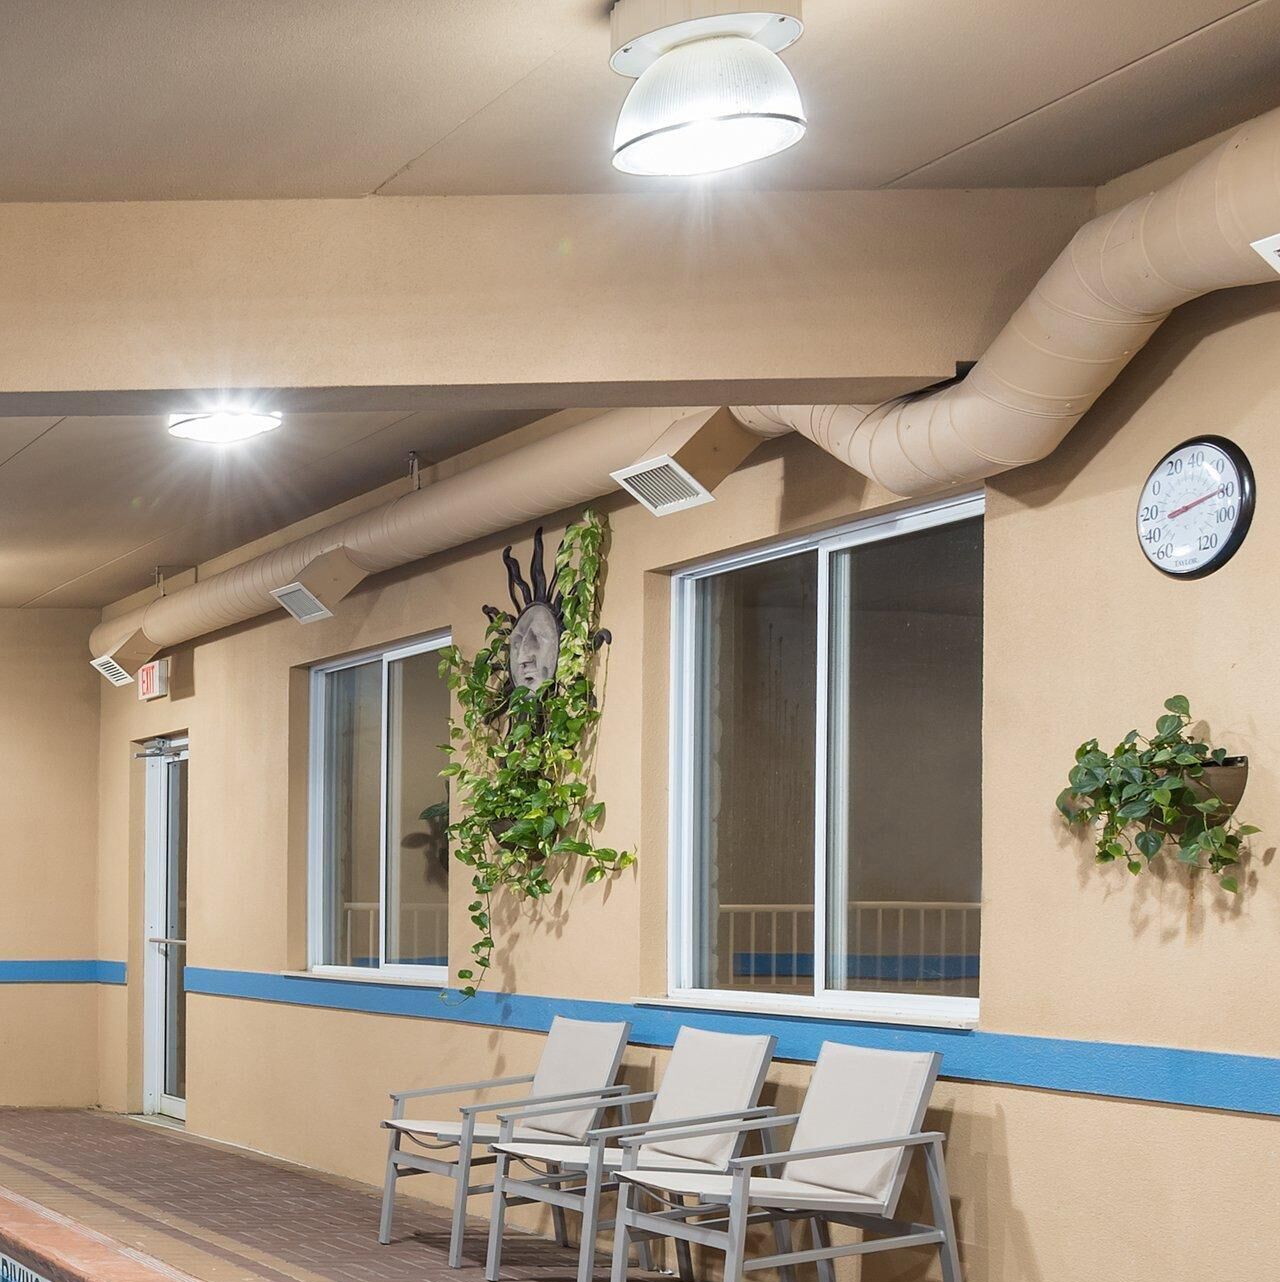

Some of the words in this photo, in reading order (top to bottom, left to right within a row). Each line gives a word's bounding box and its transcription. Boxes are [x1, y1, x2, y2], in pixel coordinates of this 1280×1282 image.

[1166, 458, 1183, 476] 20
[1187, 450, 1204, 468] 40
[1152, 480, 1161, 496] 0
[1218, 481, 1235, 499] 80
[1140, 504, 1159, 522] -20
[1215, 505, 1235, 523] 100
[1142, 527, 1161, 544] -40
[1198, 533, 1218, 551] 120
[1151, 543, 1174, 560] -60
[142, 665, 154, 695] EXIT
